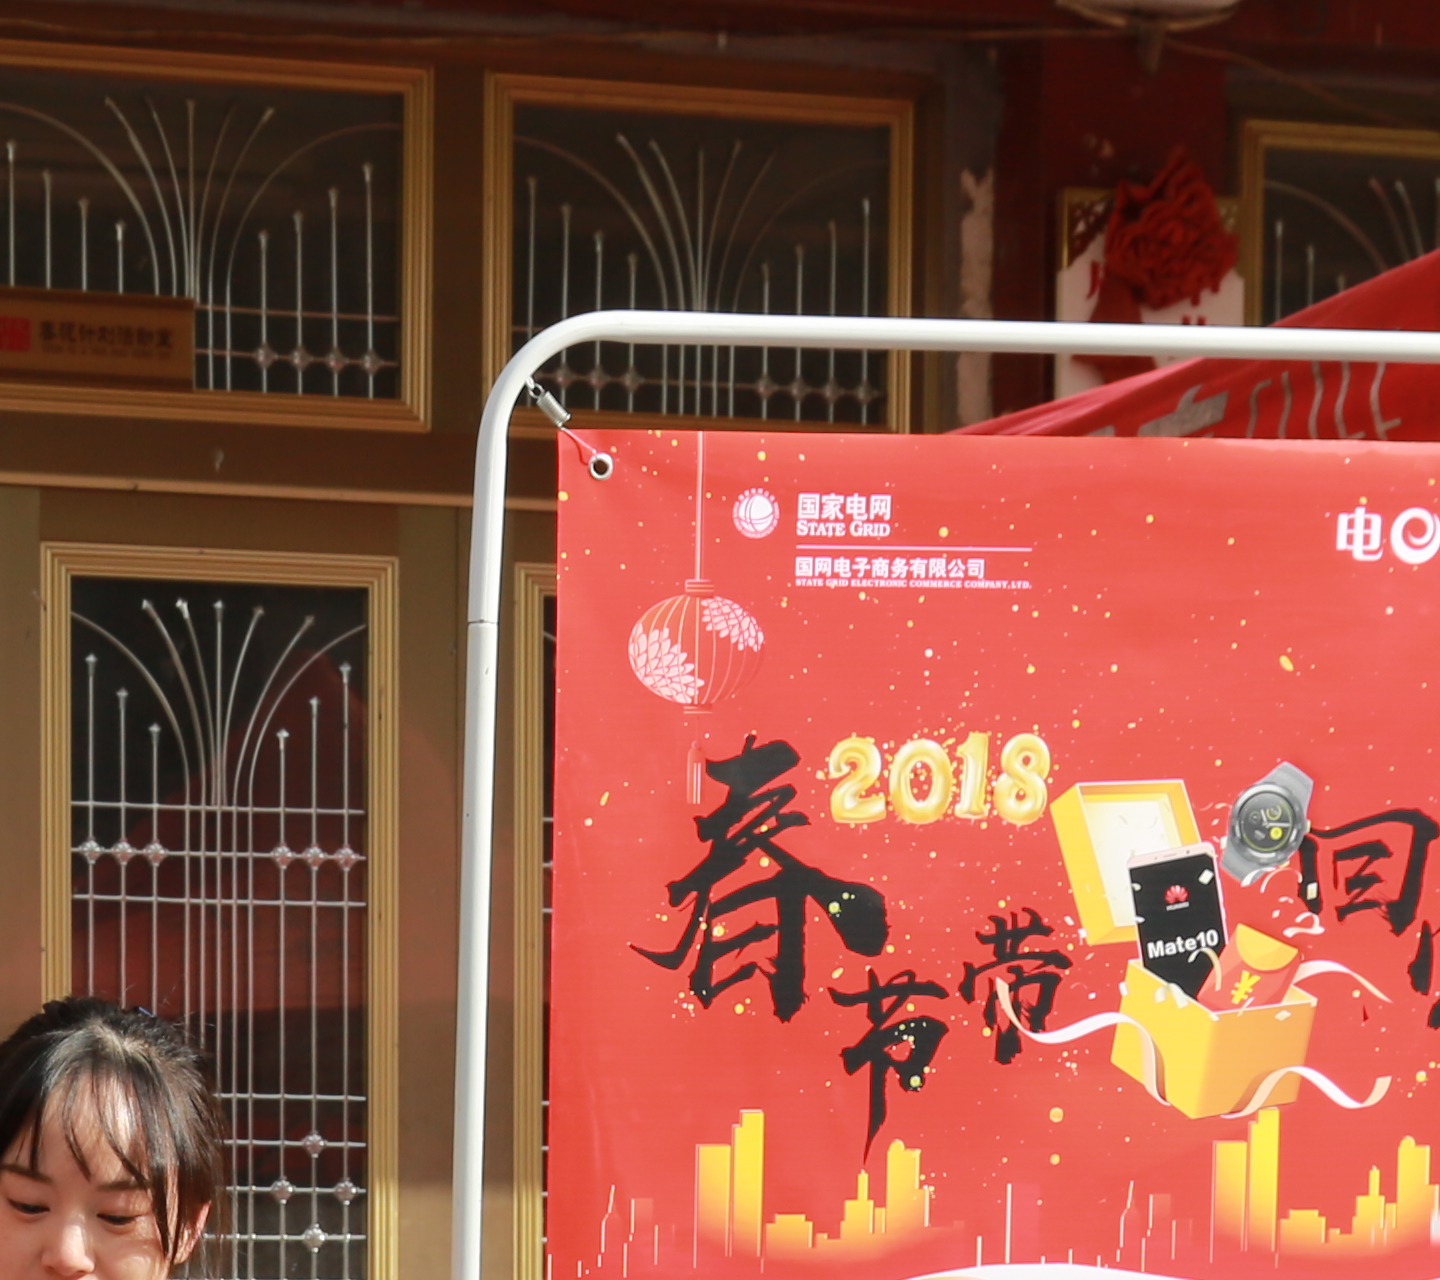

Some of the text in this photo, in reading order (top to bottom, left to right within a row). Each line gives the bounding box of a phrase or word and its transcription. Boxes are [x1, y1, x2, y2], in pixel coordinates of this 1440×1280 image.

[797, 493, 891, 520] 国家电网
[795, 556, 985, 580] 国网电子商务有限公司
[795, 579, 824, 587] STATE
[826, 579, 848, 588] GRID
[851, 579, 907, 588] ELECTRONIC
[909, 580, 963, 588] COMMERCE
[827, 731, 1051, 826] 2018
[1147, 929, 1219, 959] Mate10
